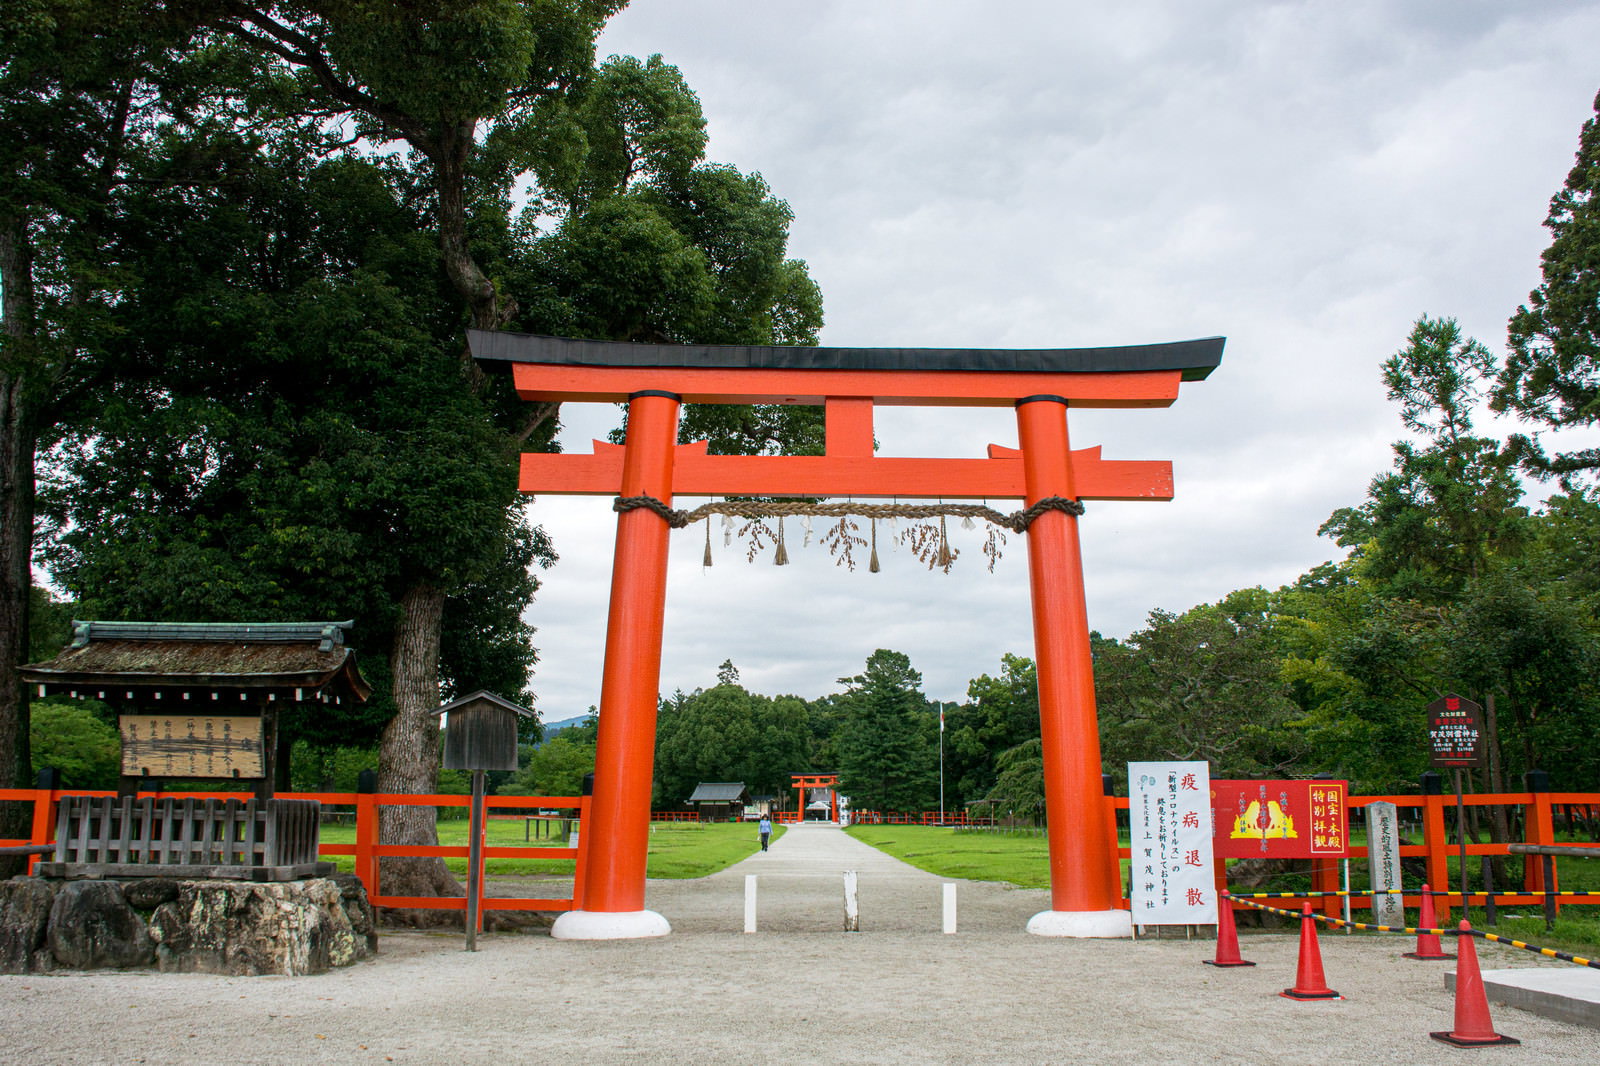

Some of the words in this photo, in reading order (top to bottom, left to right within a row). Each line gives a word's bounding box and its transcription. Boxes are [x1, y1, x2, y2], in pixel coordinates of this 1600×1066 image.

[1157, 798, 1169, 906] 終息をお祈りしております
[1168, 771, 1180, 873] 「新型コロナウイルス」の
[1180, 773, 1205, 906] 疫病退散
[1312, 790, 1327, 848] 特別拝観
[1327, 791, 1341, 848] 国宝・本殿
[1143, 831, 1155, 909] 上賀茂神社
